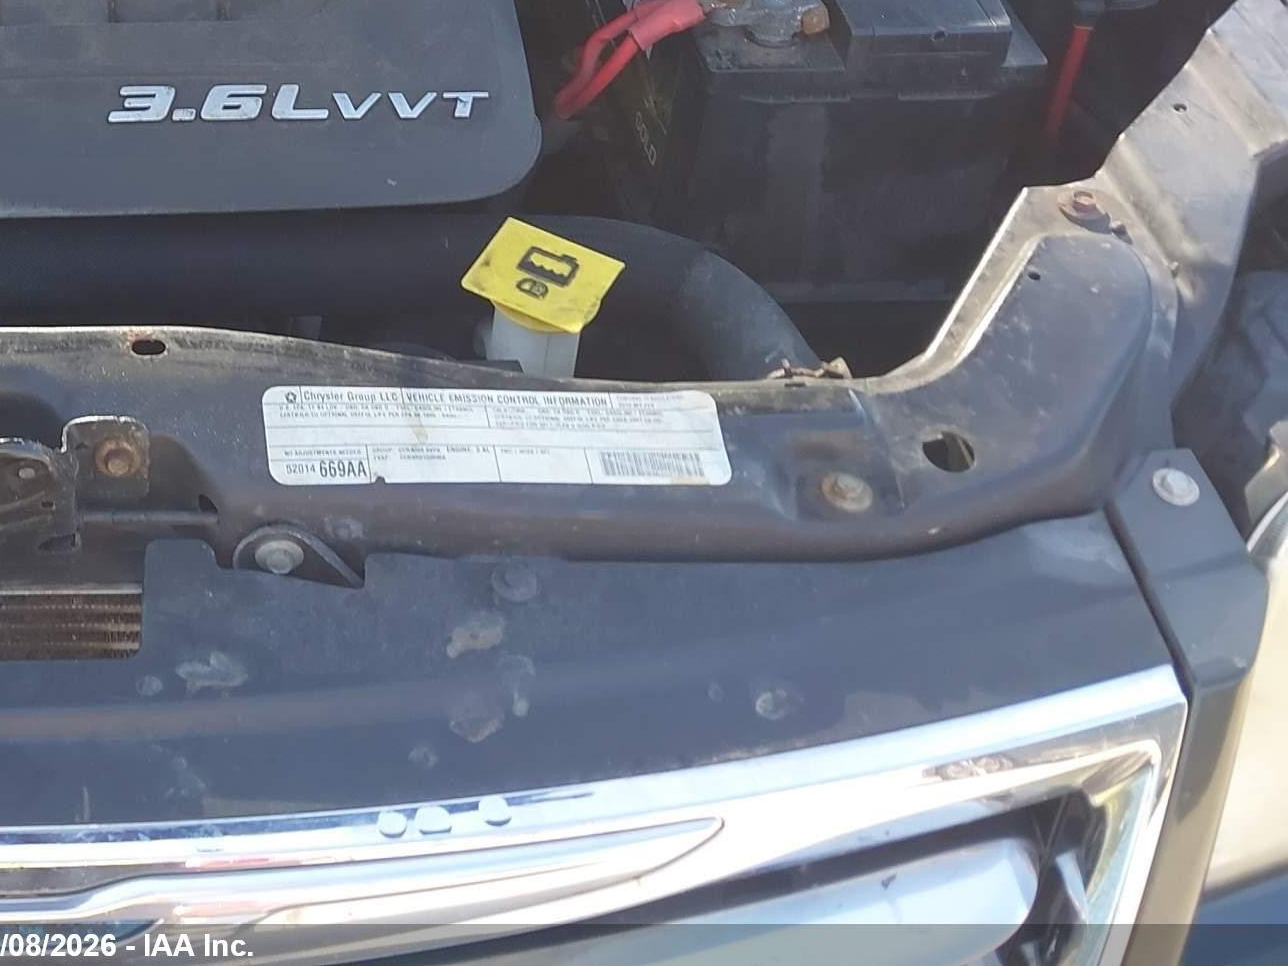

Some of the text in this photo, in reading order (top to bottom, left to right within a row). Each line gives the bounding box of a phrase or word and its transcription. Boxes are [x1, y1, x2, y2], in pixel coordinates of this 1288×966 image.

[108, 84, 489, 123] 3.6L VVT
[303, 391, 398, 404] Chrysler Group LLC
[405, 393, 445, 403] VEHICLE
[448, 394, 494, 404] EMISSION
[497, 395, 540, 405] CONTROL
[543, 396, 608, 406] INFORMATION
[319, 459, 368, 478] 669AA
